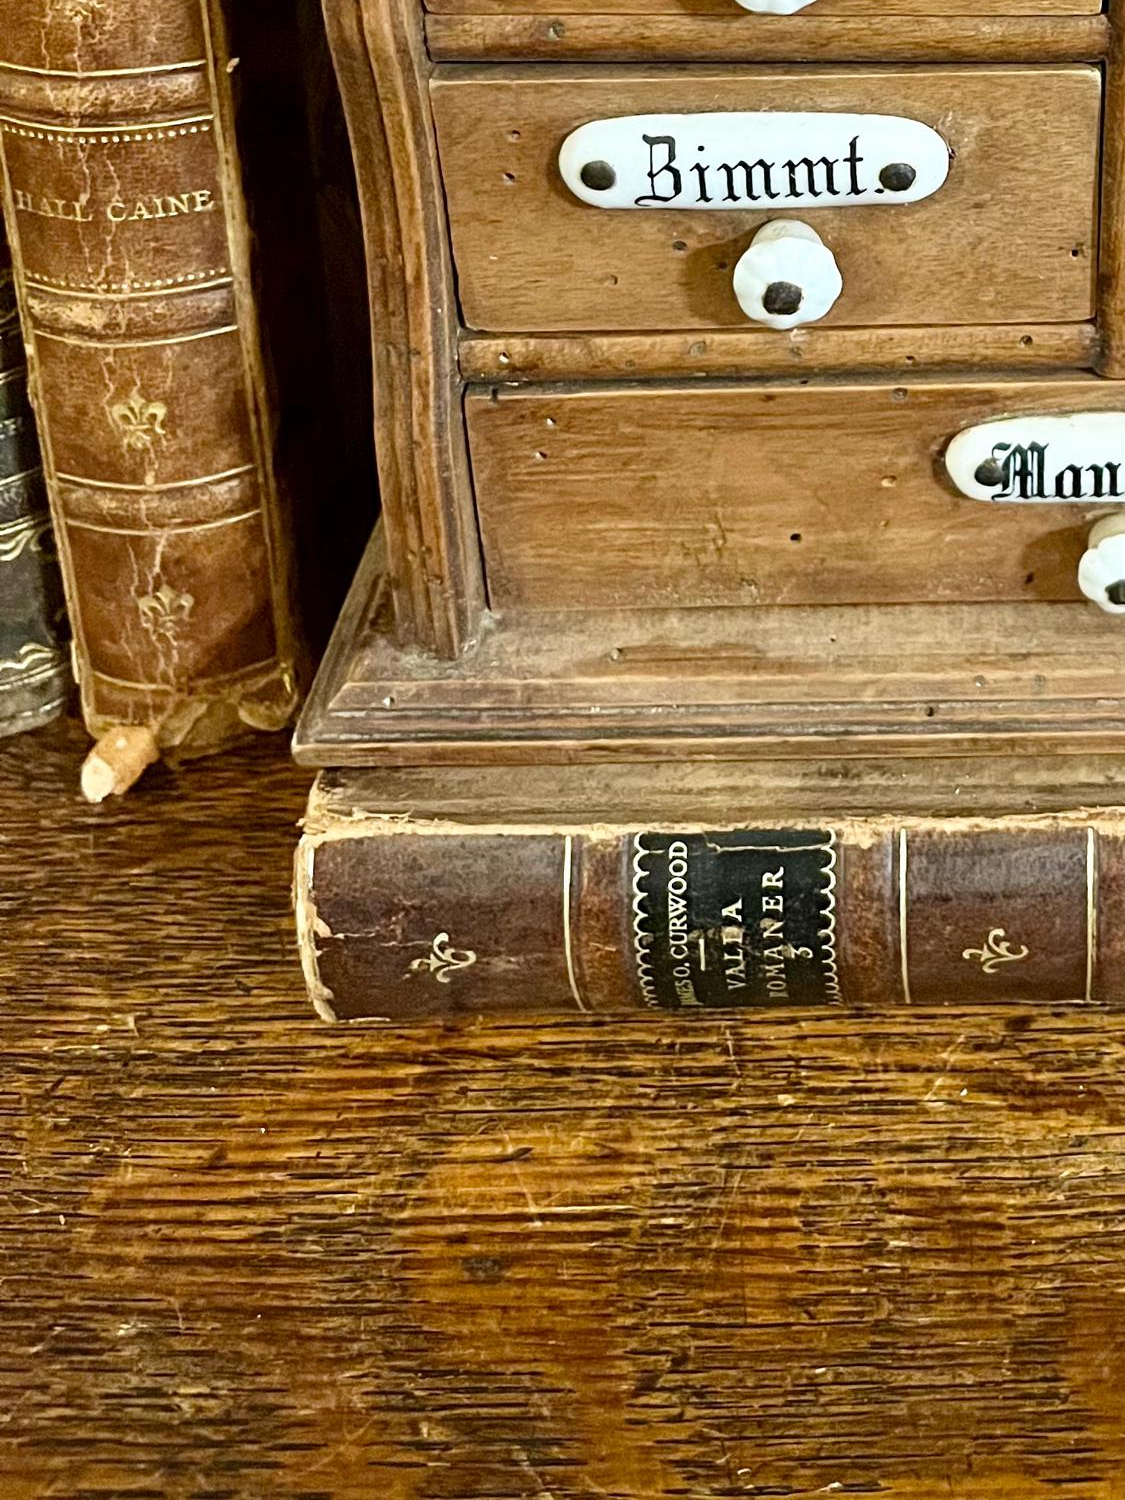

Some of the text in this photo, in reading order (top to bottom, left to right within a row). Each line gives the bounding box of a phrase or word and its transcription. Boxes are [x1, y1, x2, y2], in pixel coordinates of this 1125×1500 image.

[14, 189, 215, 222] HALL CAINE
[667, 840, 689, 960] CURWOOD
[761, 866, 789, 998] ROMANER
[672, 961, 691, 978] O.
